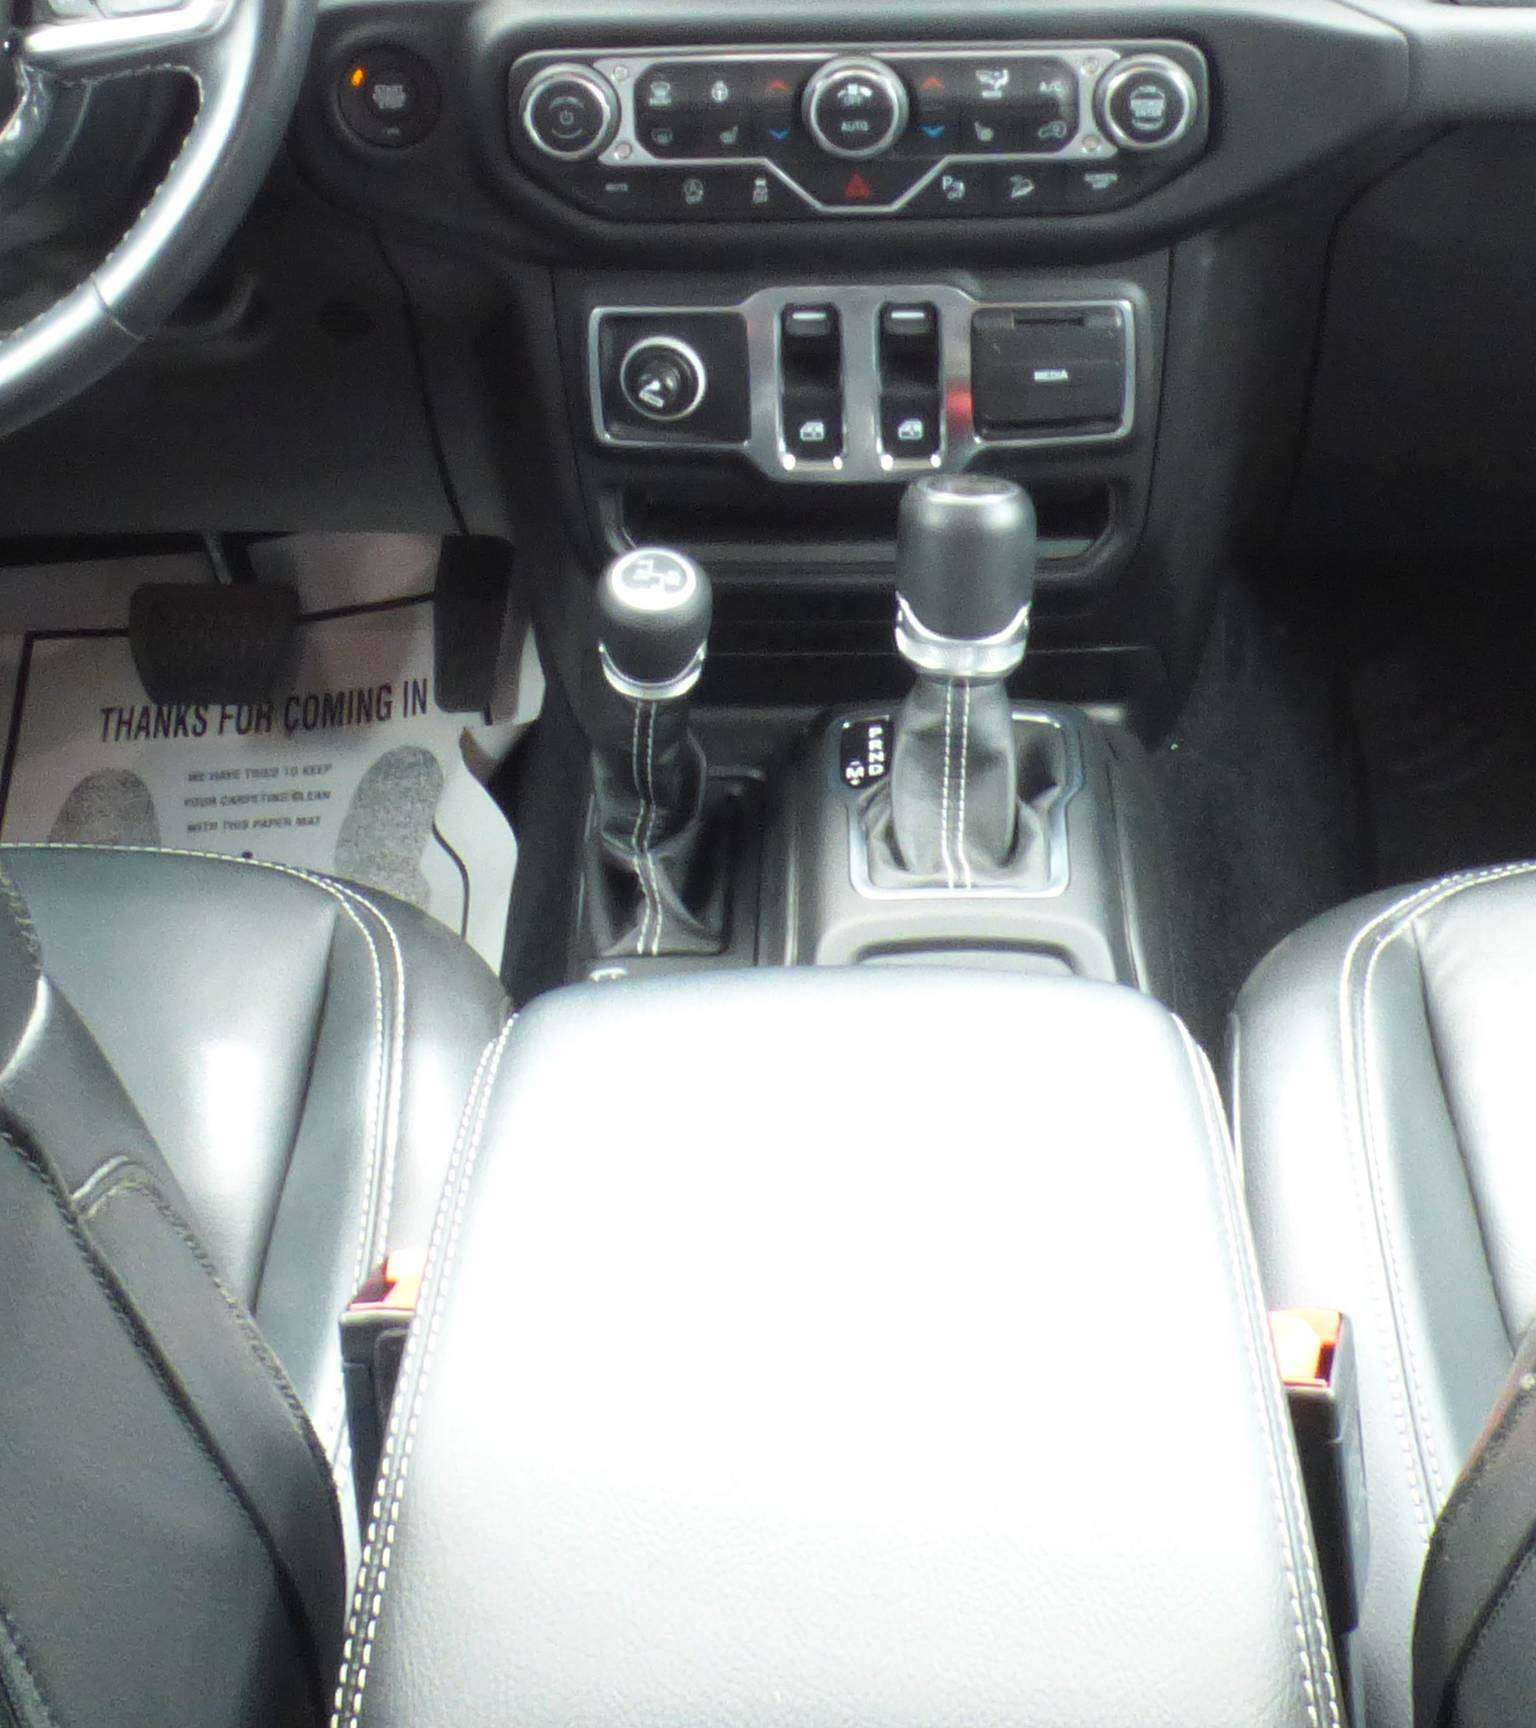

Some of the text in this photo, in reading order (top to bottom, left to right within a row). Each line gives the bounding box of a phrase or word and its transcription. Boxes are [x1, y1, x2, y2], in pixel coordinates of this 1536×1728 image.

[841, 121, 869, 132] AUTO
[100, 703, 209, 742] THANKS
[283, 683, 394, 737] COMING
[402, 678, 428, 718] IN
